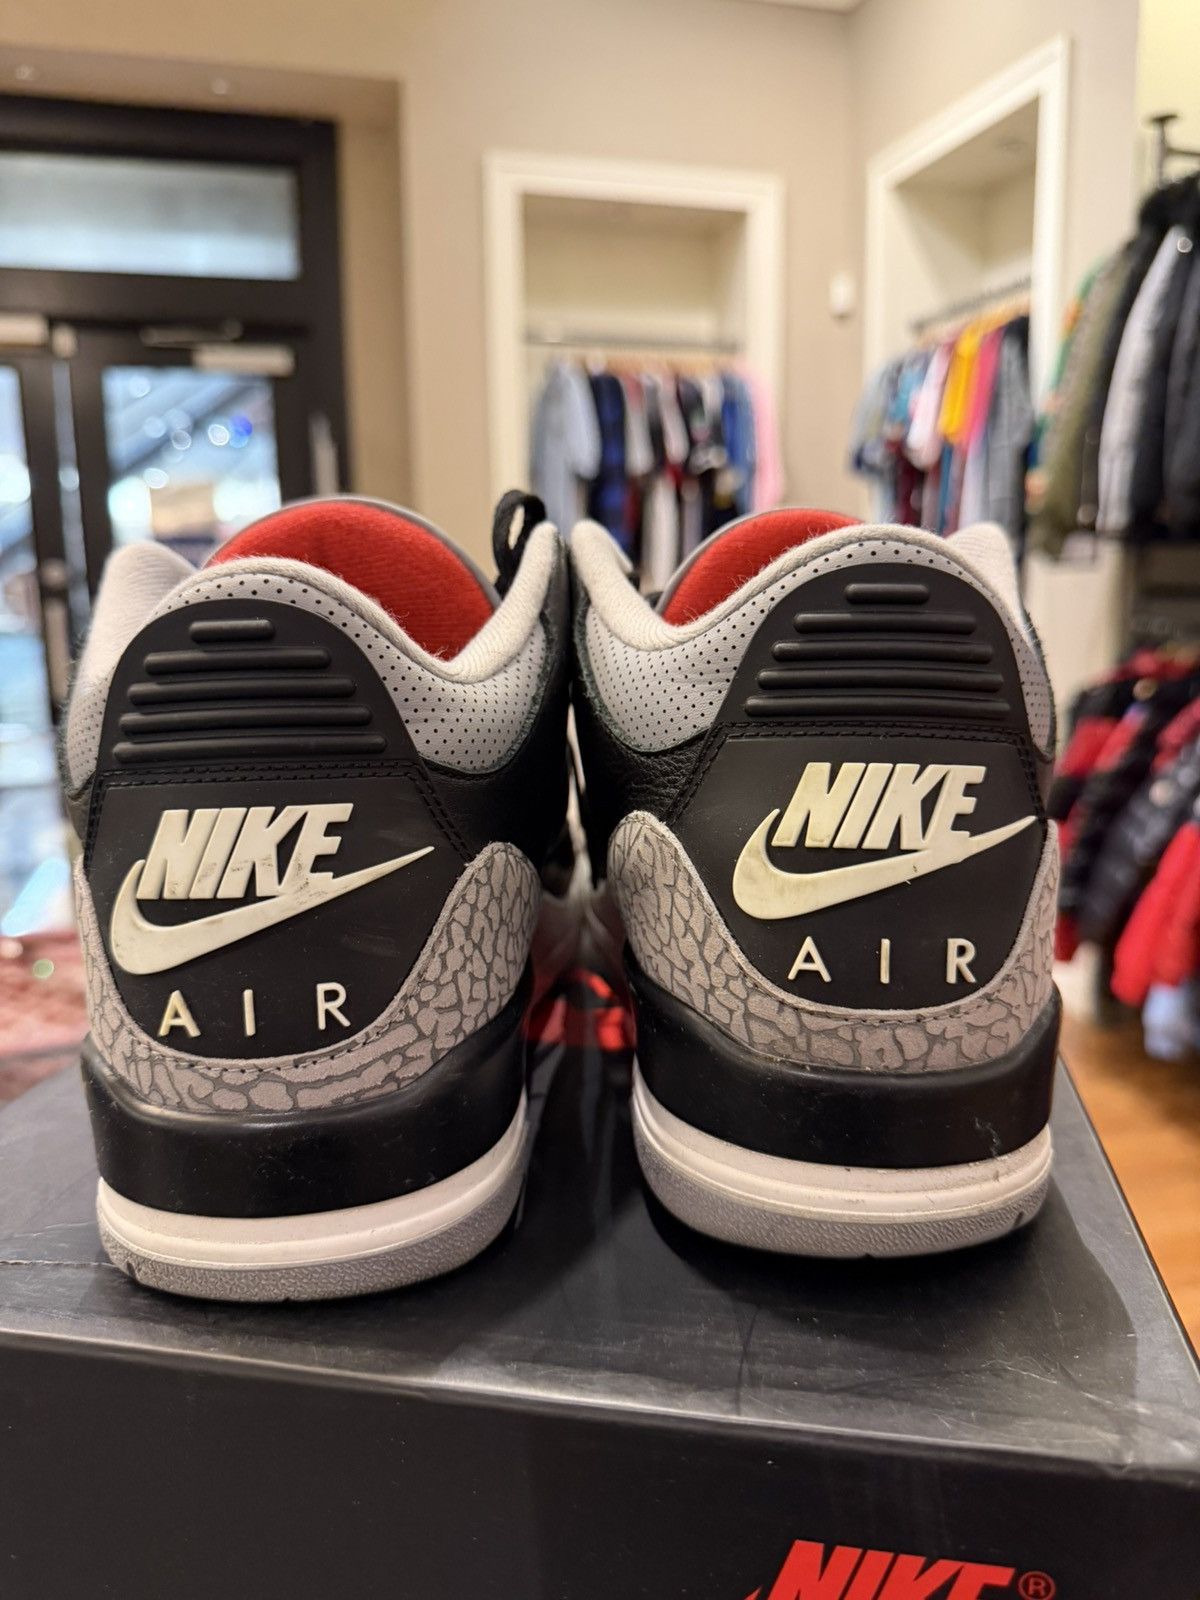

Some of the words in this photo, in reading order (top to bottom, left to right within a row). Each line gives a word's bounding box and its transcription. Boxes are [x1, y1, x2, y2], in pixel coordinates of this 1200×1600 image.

[770, 761, 987, 850] NIKE
[136, 803, 354, 900] NIKE
[787, 936, 977, 985] AIR
[158, 982, 351, 1037] AIR
